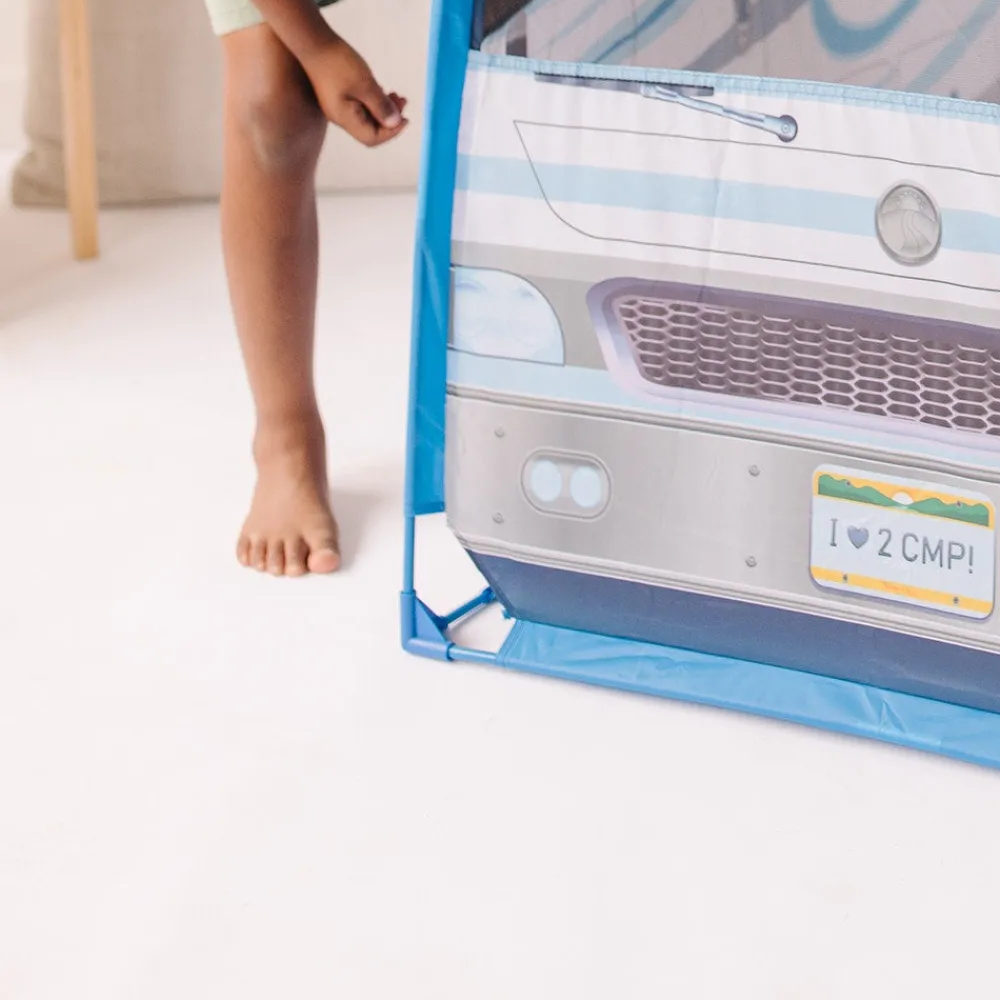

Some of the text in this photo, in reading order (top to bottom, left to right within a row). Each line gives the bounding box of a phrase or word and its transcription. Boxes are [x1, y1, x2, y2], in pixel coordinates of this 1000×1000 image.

[829, 518, 974, 574] I 2 CMP!
